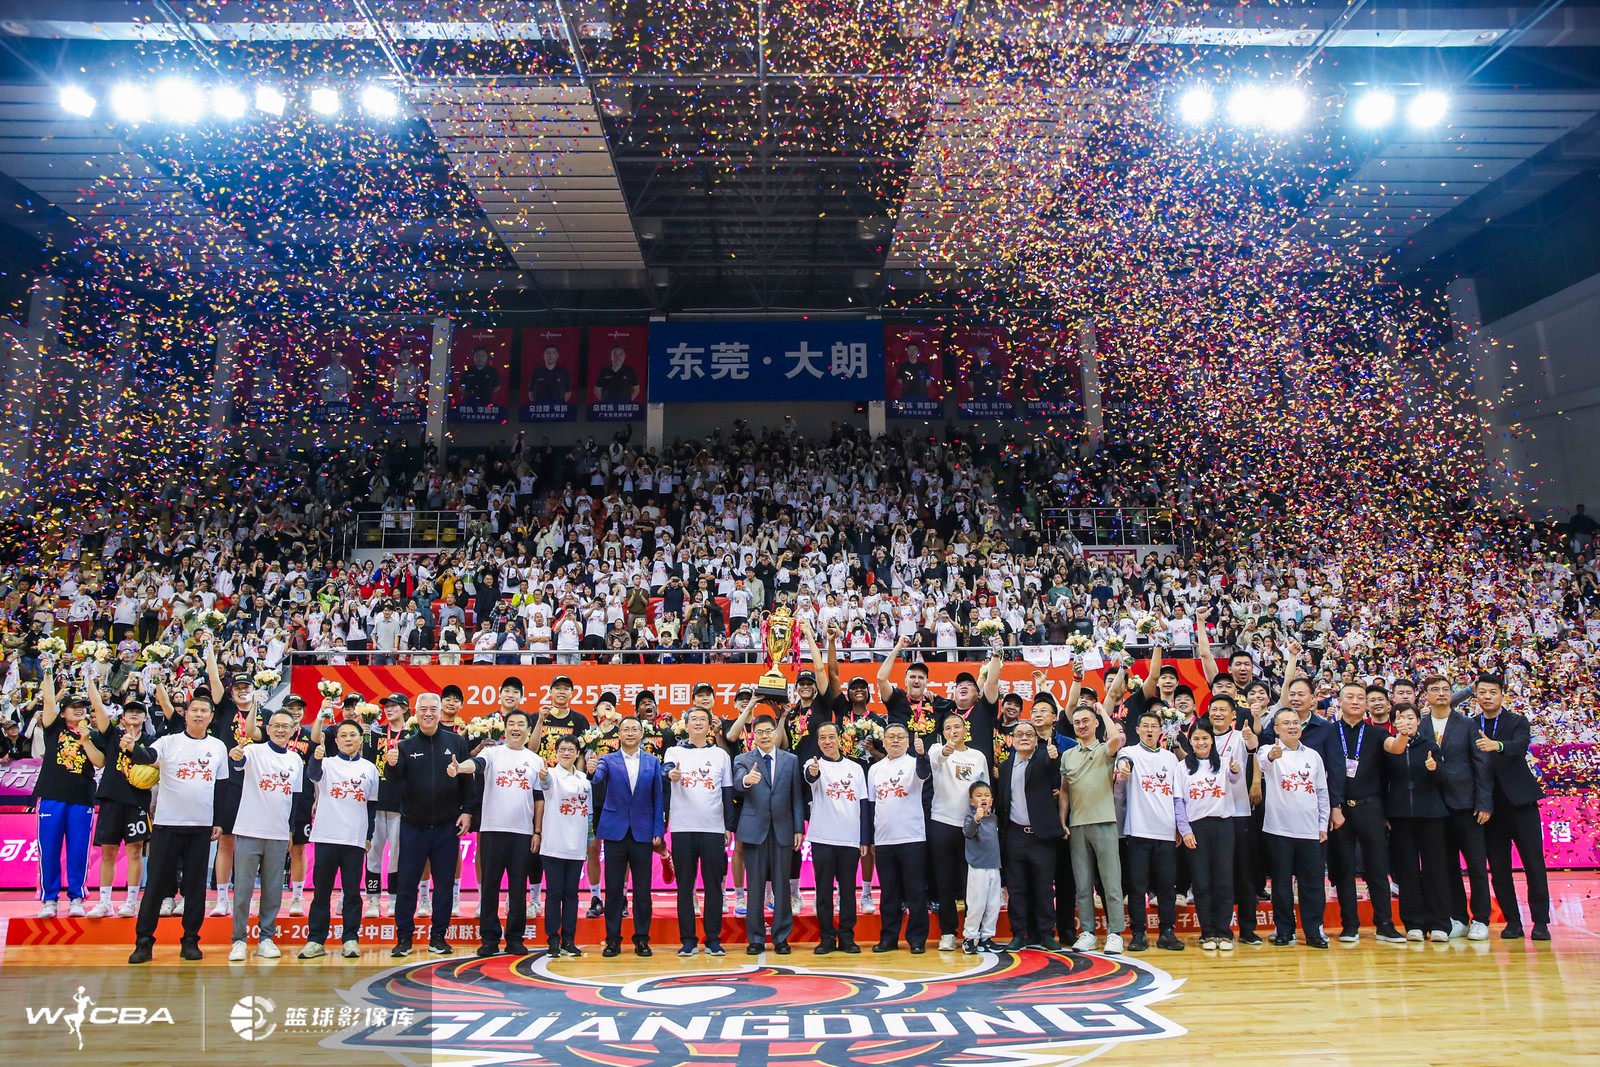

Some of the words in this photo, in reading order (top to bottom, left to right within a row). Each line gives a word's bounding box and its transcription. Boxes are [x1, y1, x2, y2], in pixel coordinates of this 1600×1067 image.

[666, 341, 869, 381] 东莞·大朗
[127, 820, 147, 837] 30
[367, 879, 378, 889] 22
[511, 1010, 664, 1018] WOMEN
[708, 1003, 1012, 1017] BASKETBALL
[363, 1002, 1147, 1042] GUANGDONG
